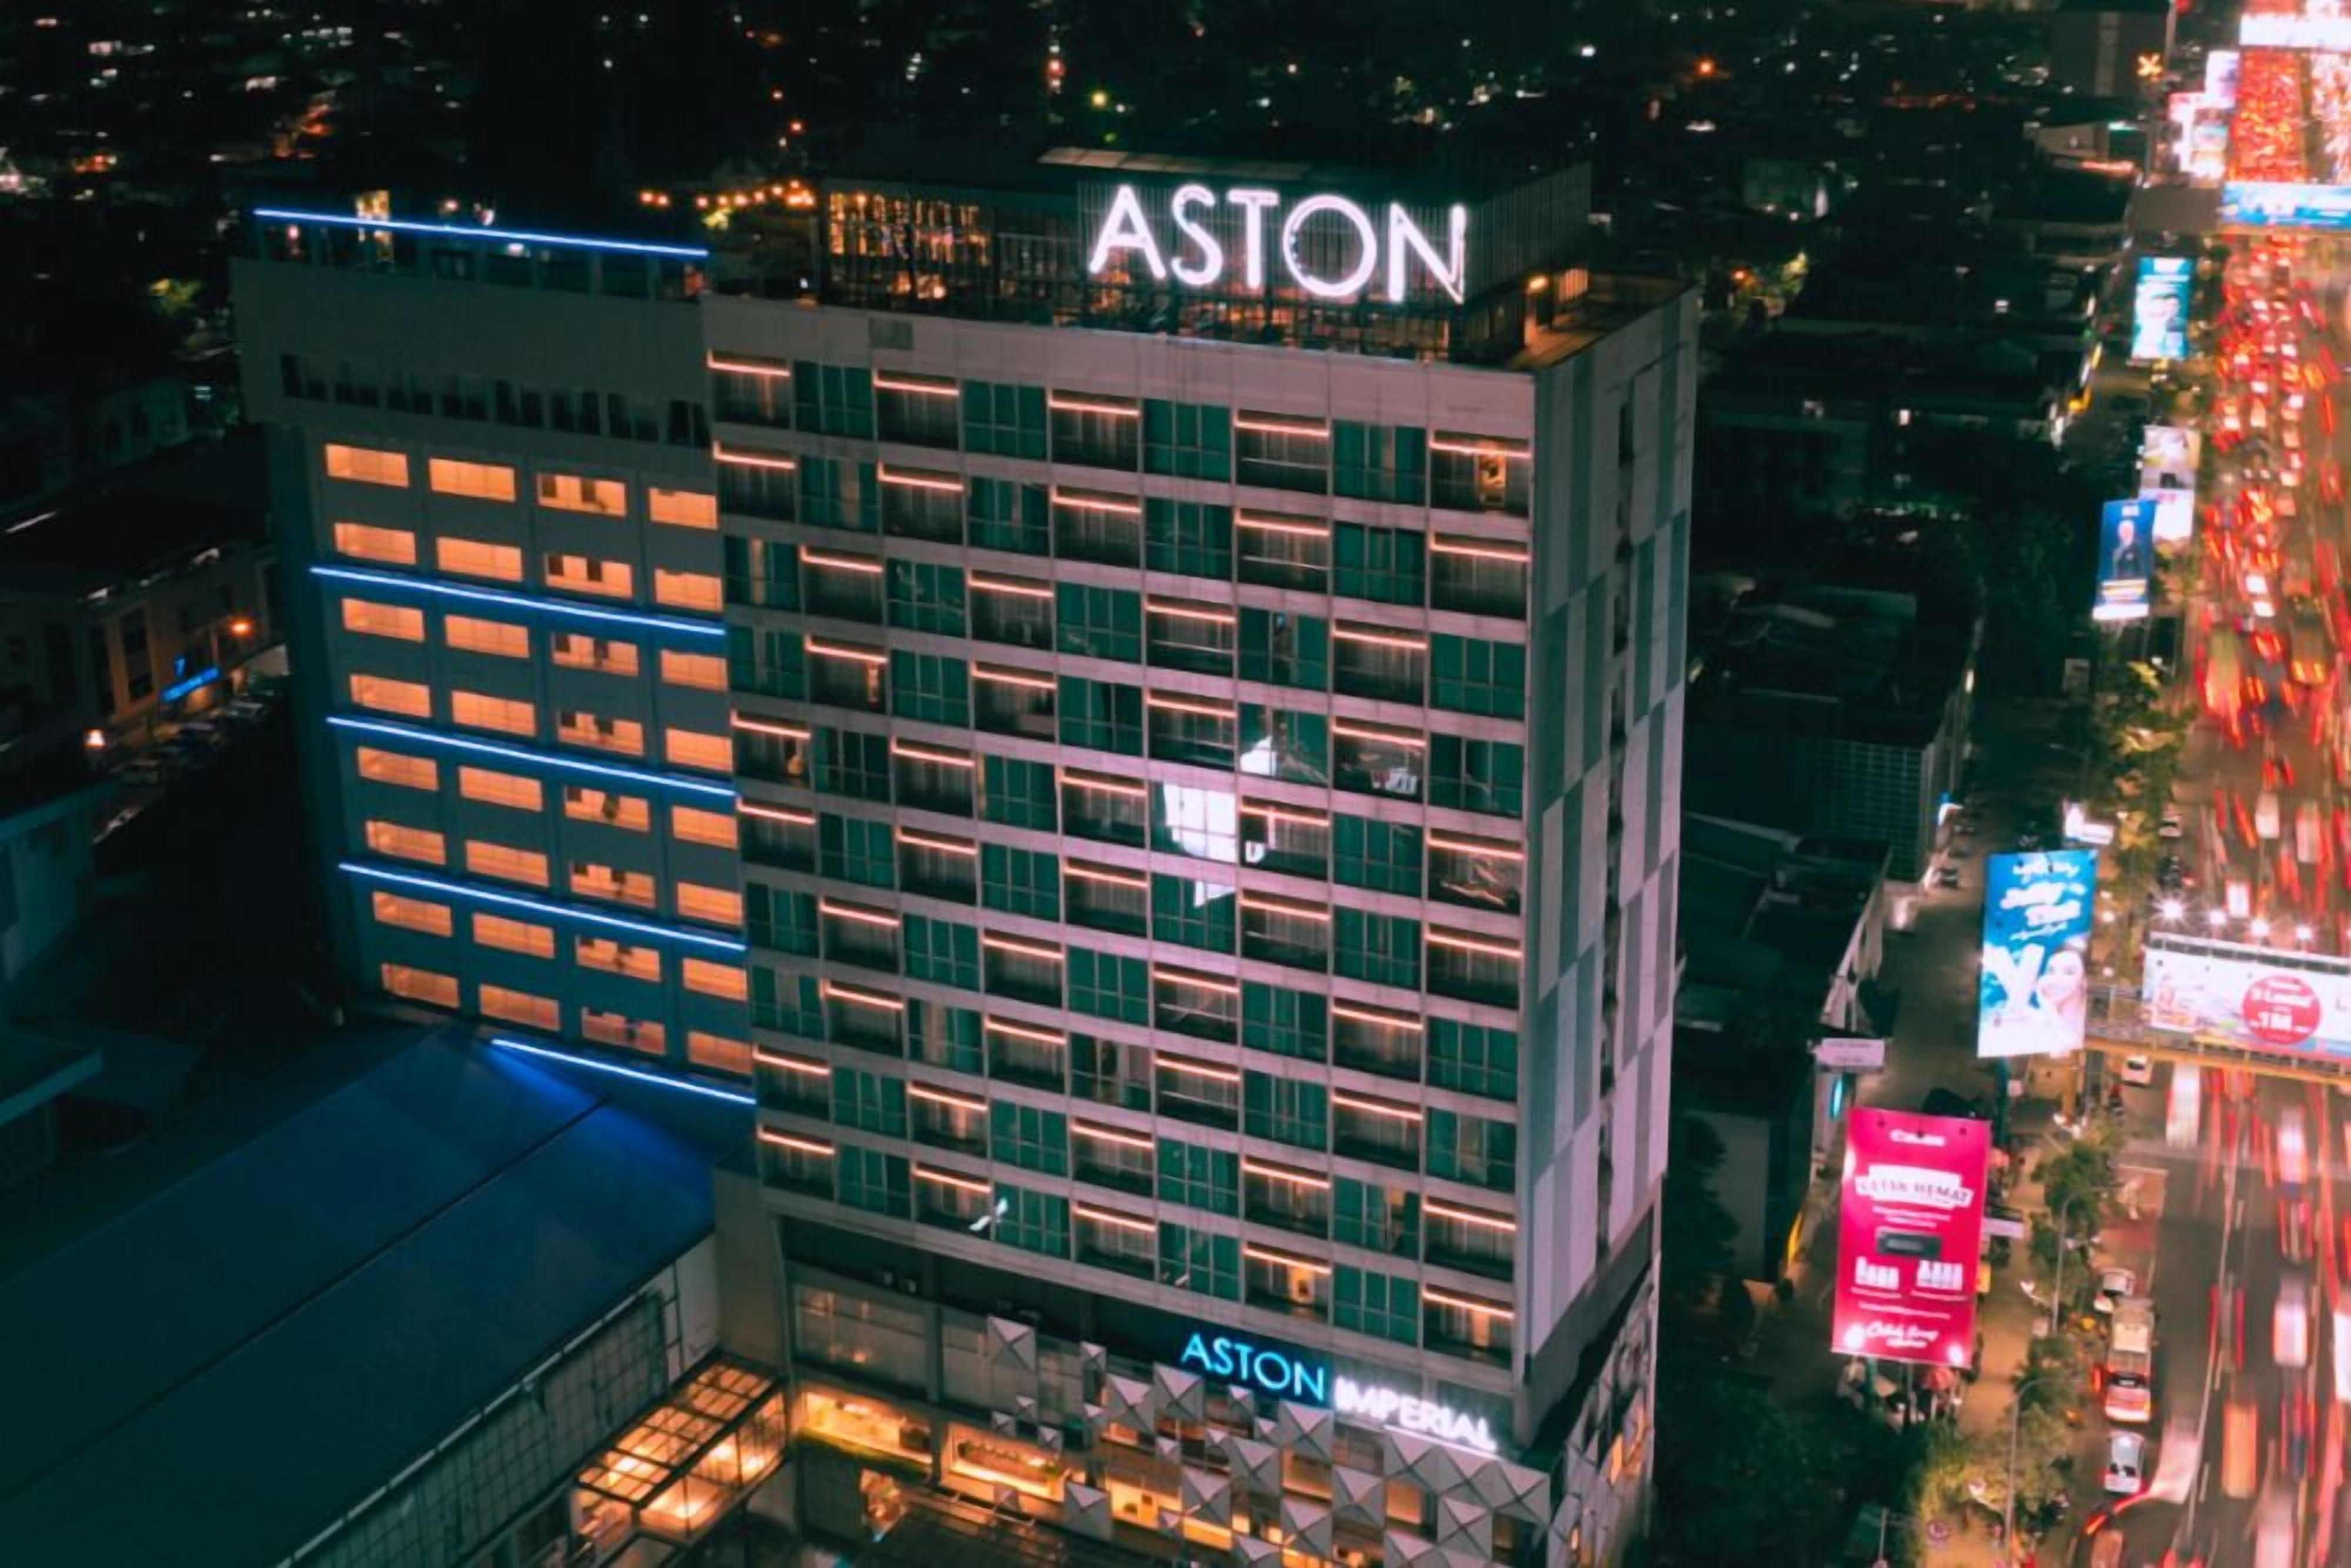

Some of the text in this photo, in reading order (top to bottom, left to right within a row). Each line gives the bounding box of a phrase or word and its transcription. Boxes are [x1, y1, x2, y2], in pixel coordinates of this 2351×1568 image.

[1089, 184, 1466, 303] ASTON
[1181, 1332, 1498, 1452] ASTON IMPERIAL
